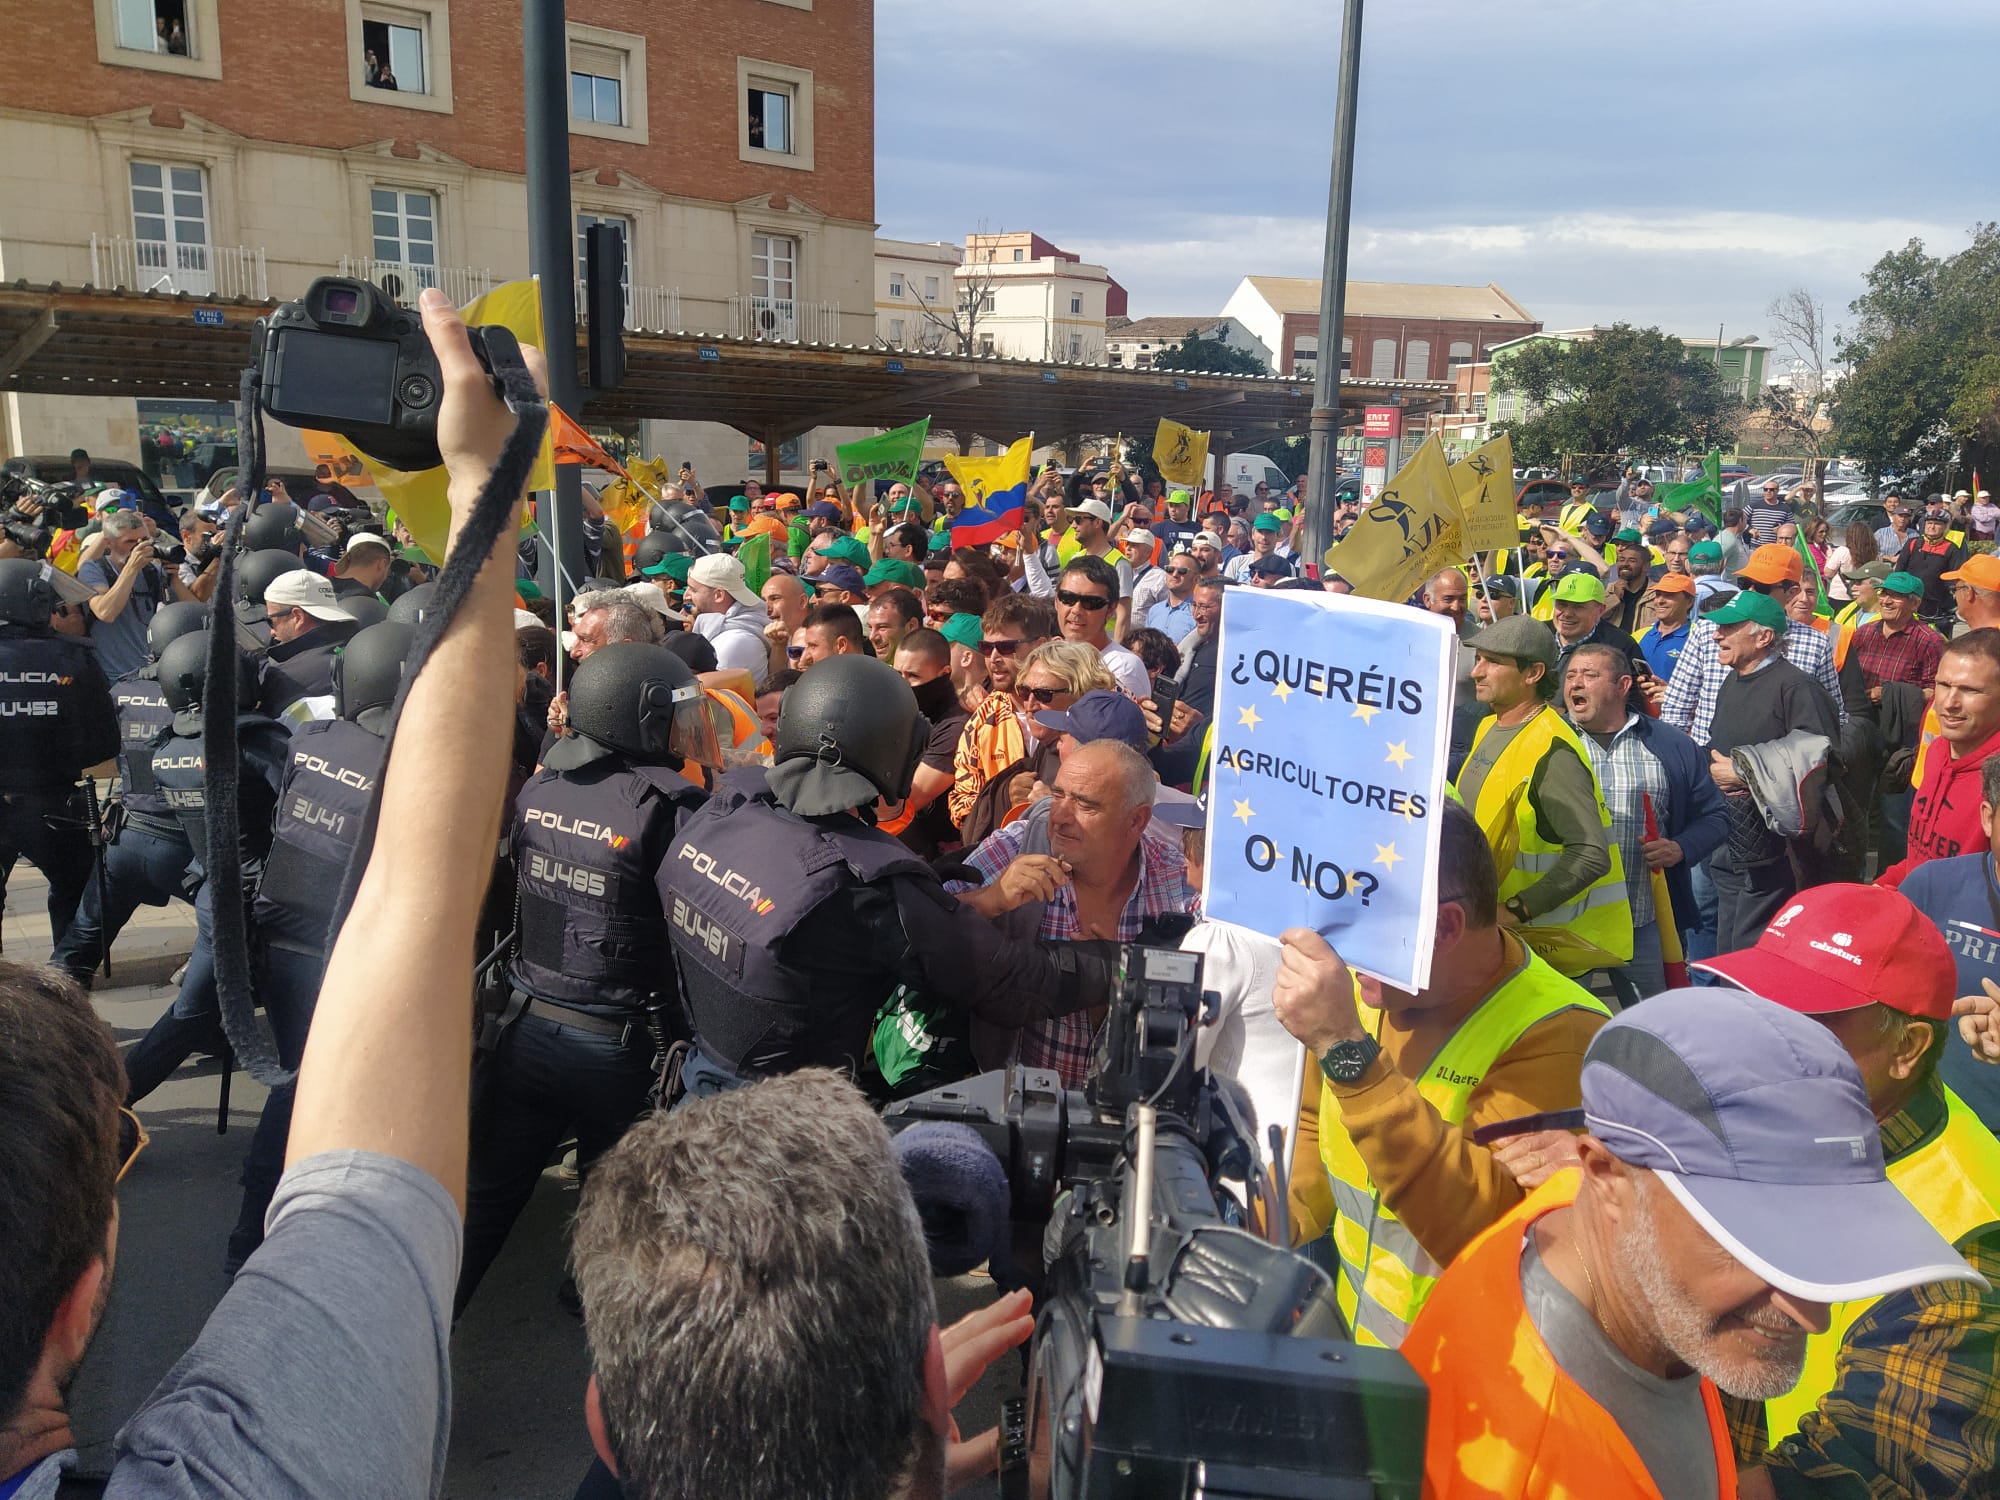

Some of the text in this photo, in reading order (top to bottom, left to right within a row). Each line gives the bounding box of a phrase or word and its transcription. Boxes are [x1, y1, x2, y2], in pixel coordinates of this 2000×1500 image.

[1366, 413, 1390, 421] EMT
[1231, 649, 1423, 716] ¿QUERÉIS
[0, 700, 58, 716] U452
[151, 756, 202, 771] POLICIA
[1216, 744, 1427, 819] AGRICULTORES
[291, 797, 345, 835] 3U41
[524, 808, 613, 844] POLICIA
[530, 854, 606, 897] 3U485
[678, 842, 761, 907] POLICIA
[1245, 834, 1380, 907] O NO?
[672, 898, 729, 962] 3U481
